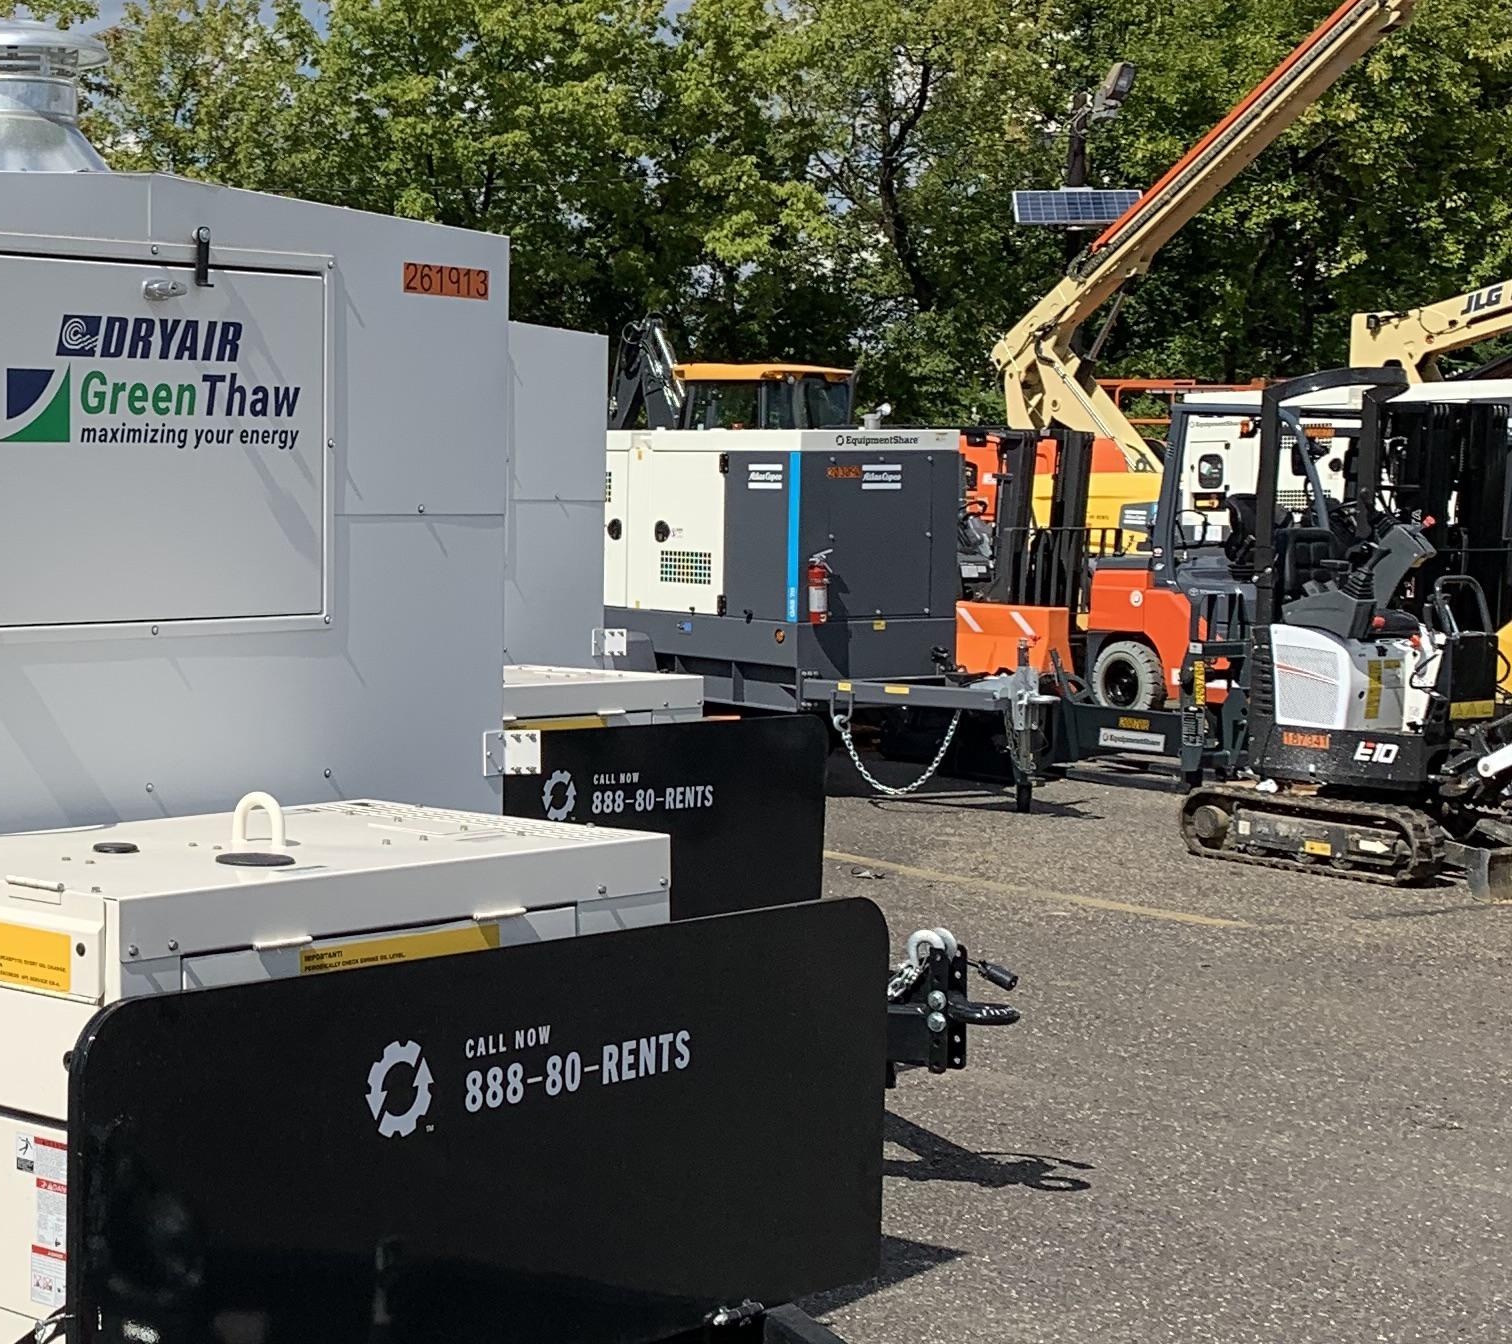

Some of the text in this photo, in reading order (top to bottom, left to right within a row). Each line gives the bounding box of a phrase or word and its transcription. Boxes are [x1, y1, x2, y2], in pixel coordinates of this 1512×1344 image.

[406, 263, 487, 297] 261913
[1461, 286, 1502, 316] JLG
[100, 316, 243, 362] DRYAIR
[79, 369, 301, 418] Green Thaw
[80, 423, 300, 450] maximizing your energy
[846, 435, 919, 446] EquipmentShare
[1354, 741, 1399, 763] E10
[593, 772, 640, 784] CALL NOW
[592, 786, 714, 813] 888-80-RENTS
[465, 1025, 551, 1058] CALL NOW
[464, 1030, 691, 1113] 888-80-RENTS
